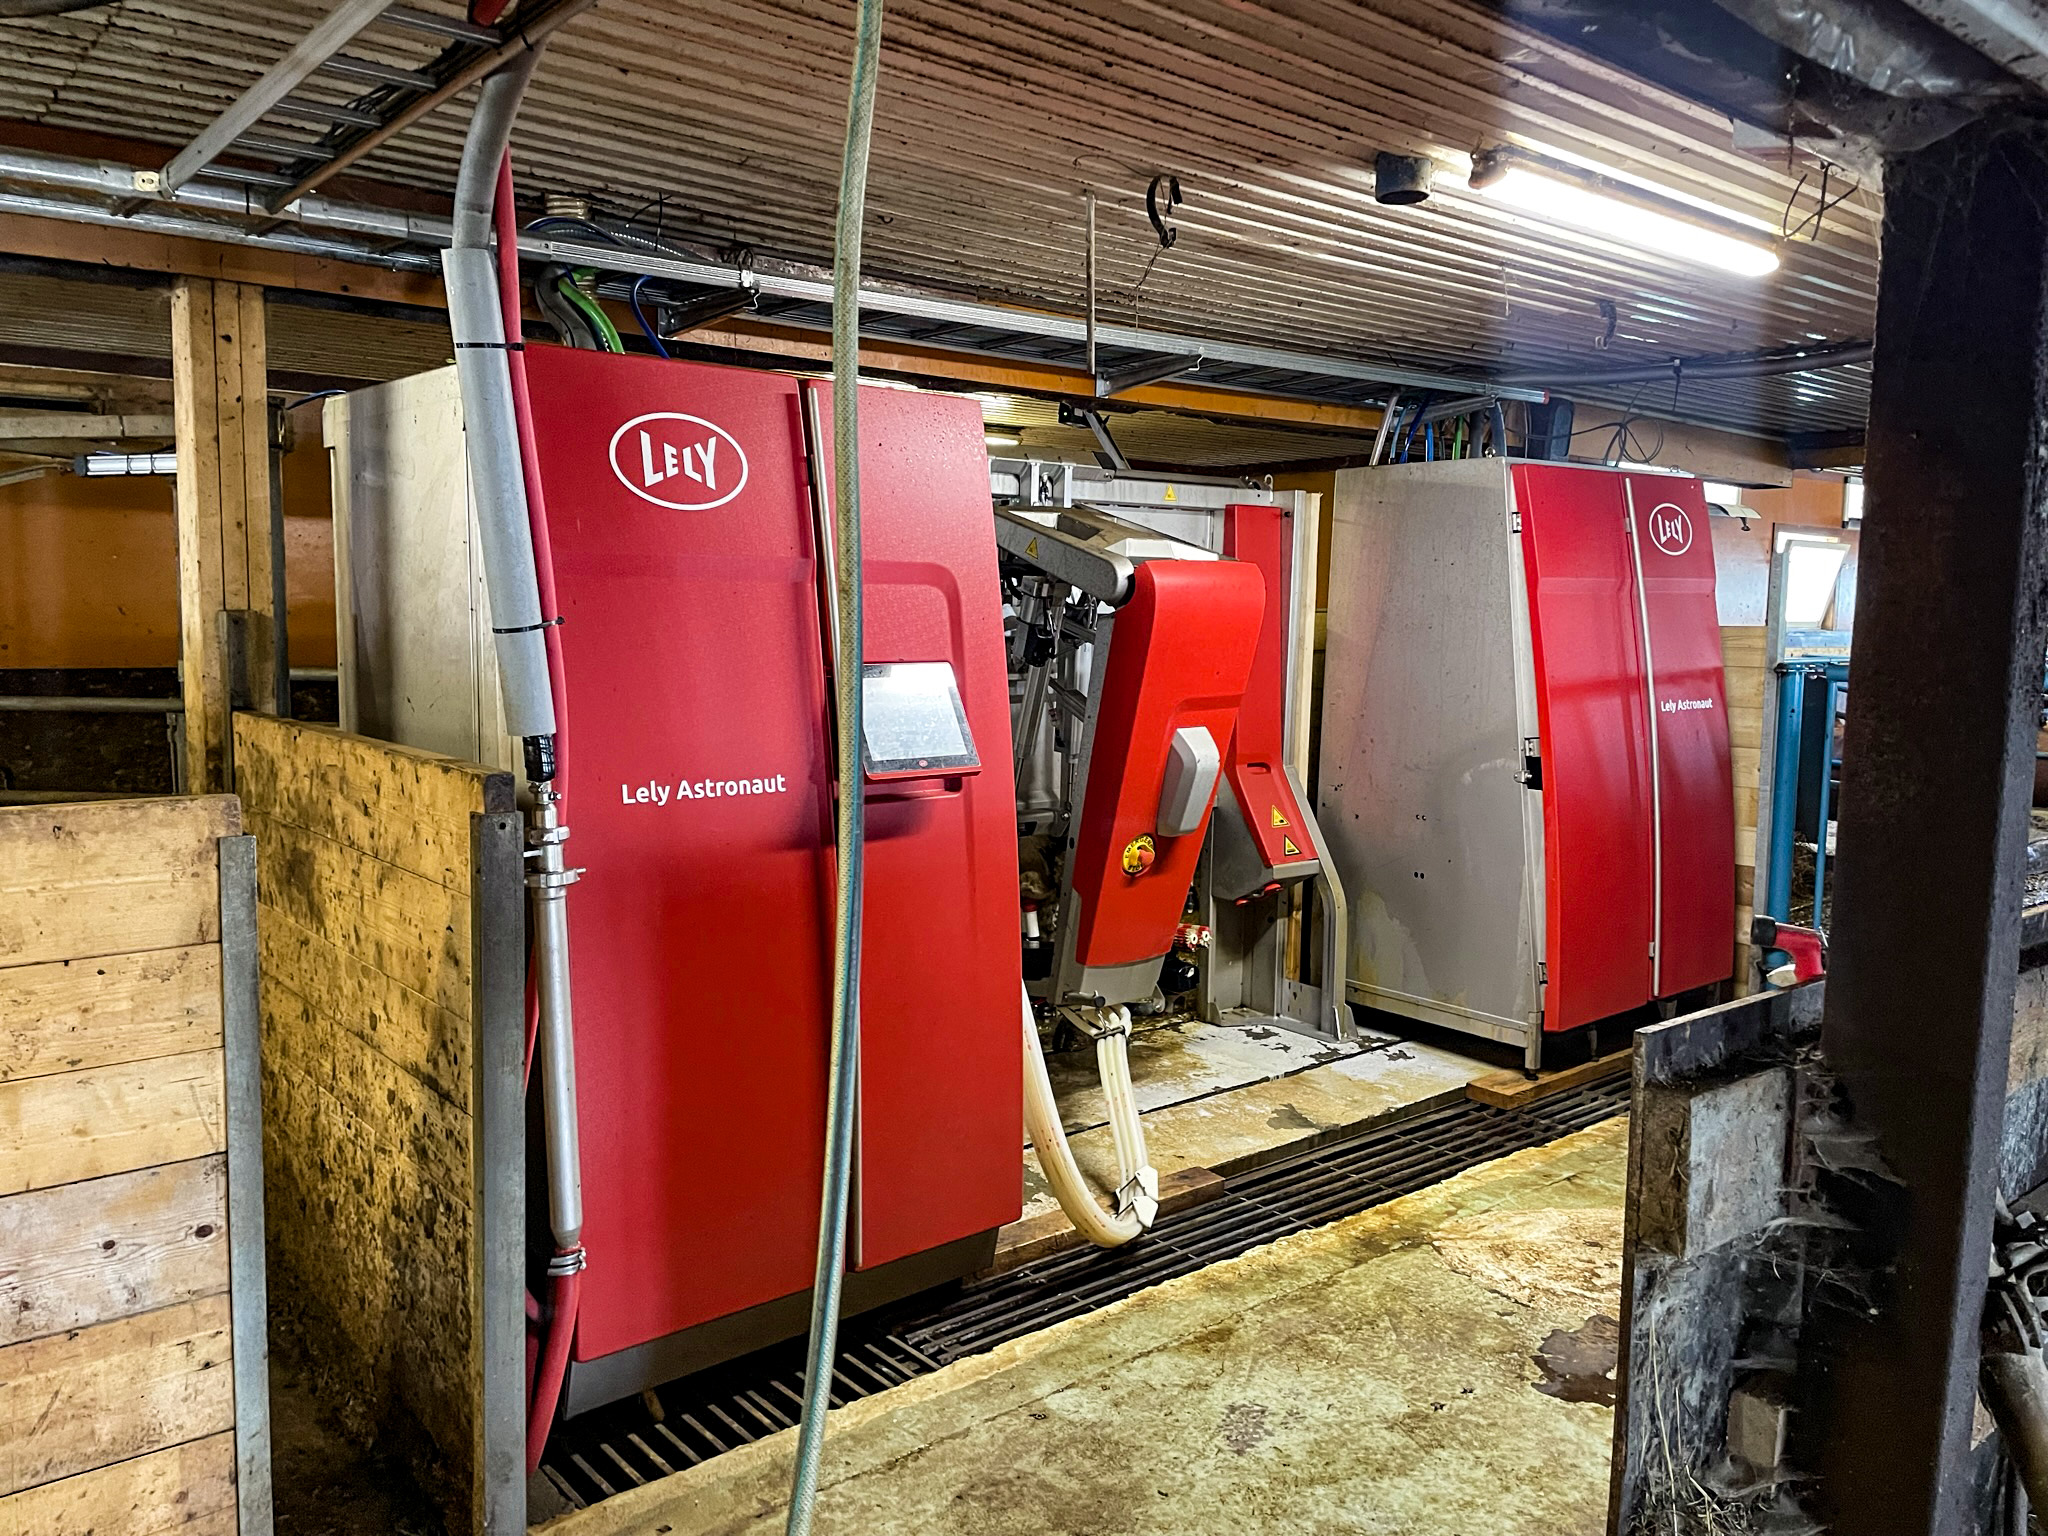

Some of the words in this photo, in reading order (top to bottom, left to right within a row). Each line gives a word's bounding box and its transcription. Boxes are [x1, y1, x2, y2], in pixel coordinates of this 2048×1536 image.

[640, 429, 717, 491] LELY
[1657, 513, 1684, 544] LELY
[1660, 699, 1677, 714] Lely
[1678, 697, 1713, 711] Astronaut
[621, 780, 671, 806] Lely
[676, 774, 786, 800] Astronaut
